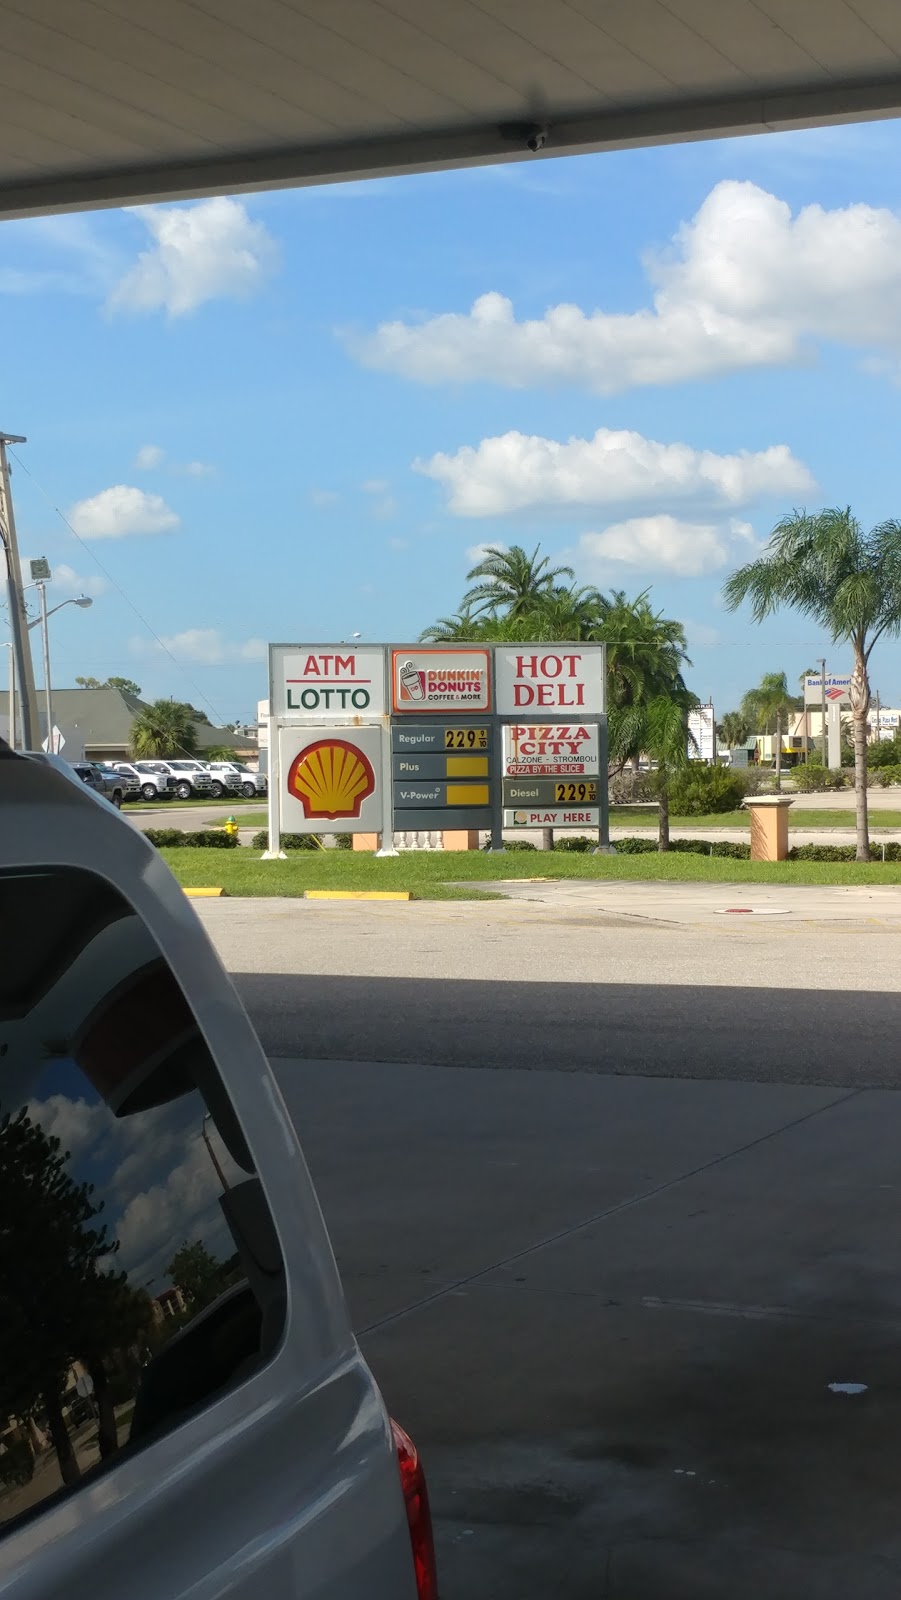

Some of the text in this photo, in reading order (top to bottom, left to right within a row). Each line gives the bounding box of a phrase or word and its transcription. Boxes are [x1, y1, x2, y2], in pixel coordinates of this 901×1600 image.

[303, 655, 355, 675] ATM
[515, 655, 582, 678] HOT
[428, 670, 483, 681] DUNKIN'
[428, 682, 481, 692] DONUTS
[287, 688, 370, 709] LOTTO
[513, 683, 585, 706] DELI
[511, 727, 591, 740] PIZZA
[399, 734, 435, 744] Regular
[520, 742, 583, 755] CITY
[506, 756, 542, 764] CALZONE
[553, 755, 597, 763] STROMBOLI
[400, 763, 419, 771] Plus
[509, 764, 580, 774] PIZZA BY THE SLICE
[400, 791, 439, 799] V-Power
[510, 788, 539, 797] Diesel
[530, 812, 591, 822] PLAY HERE
